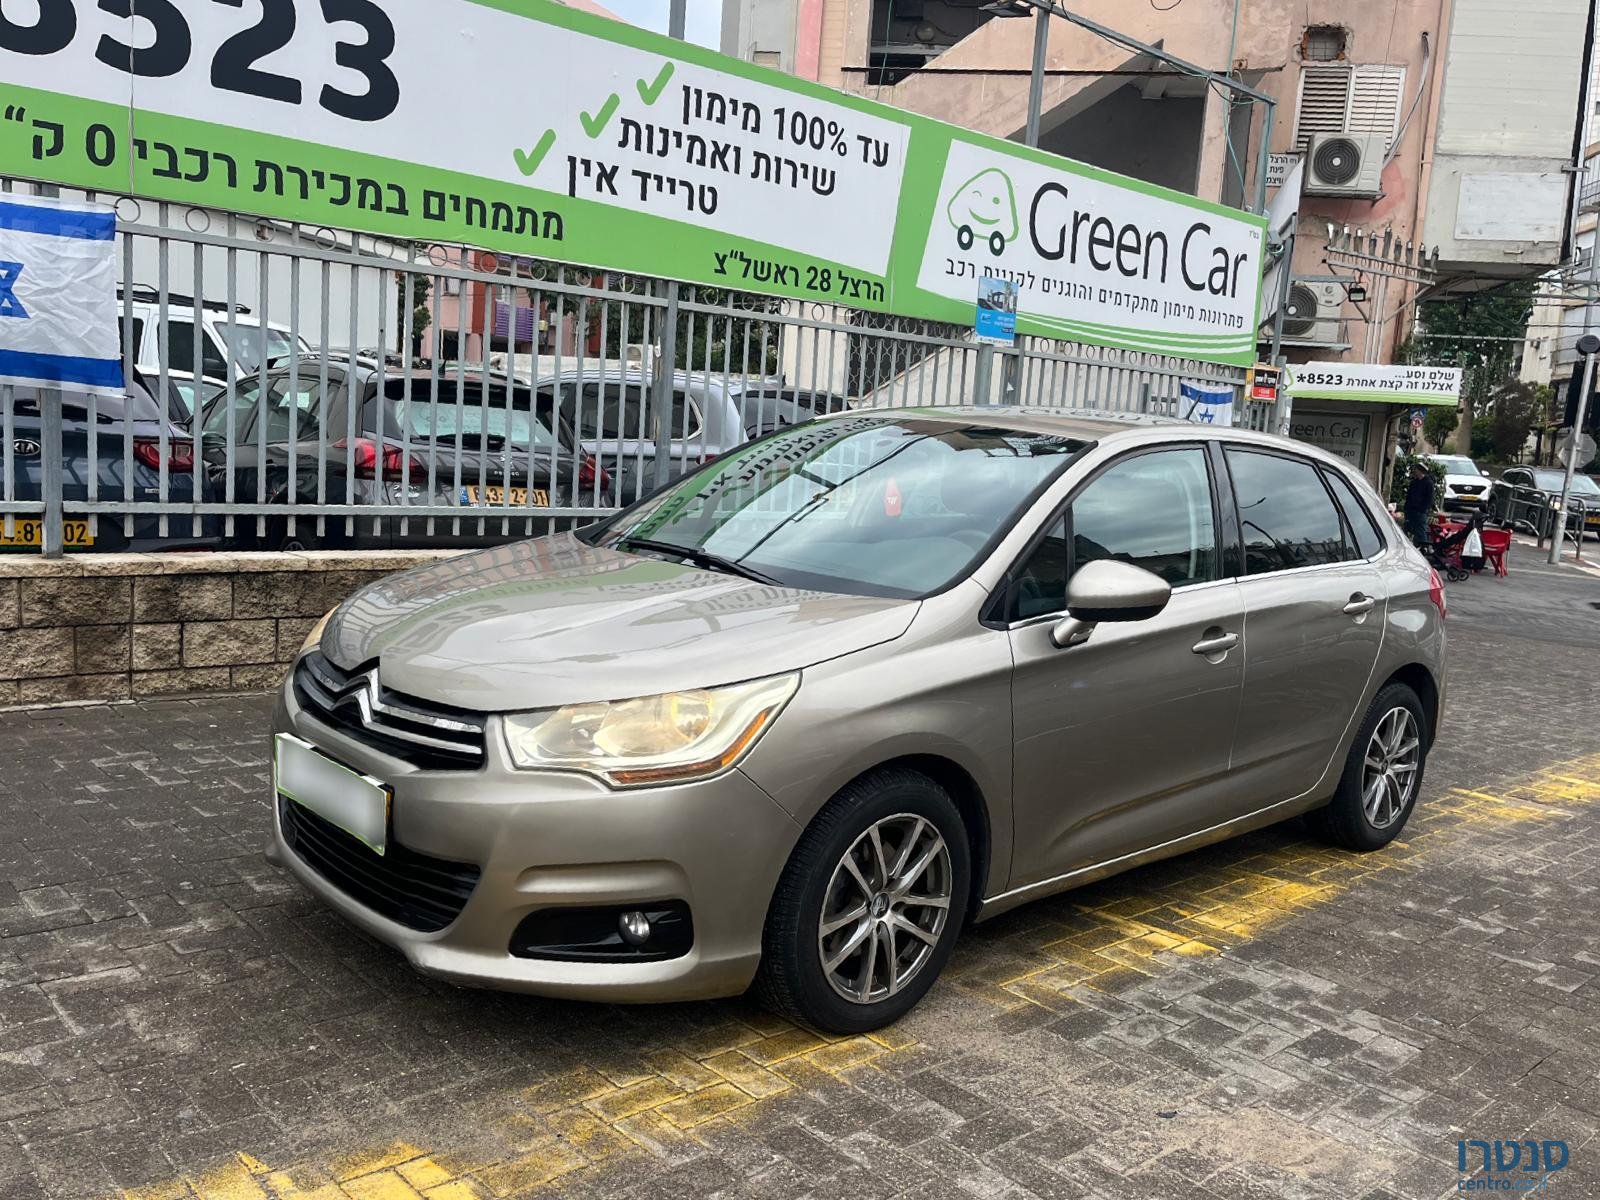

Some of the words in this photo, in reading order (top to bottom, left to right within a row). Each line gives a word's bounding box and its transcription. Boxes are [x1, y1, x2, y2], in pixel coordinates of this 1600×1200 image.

[682, 85, 761, 134] מימון
[86, 124, 116, 168] 0
[774, 108, 847, 157] 100%
[618, 118, 742, 175] ואמינות
[856, 135, 889, 168] עד
[1270, 154, 1288, 164] הרצל
[133, 138, 238, 189] רכבי
[750, 151, 836, 196] שירות
[1269, 165, 1285, 174] פינת
[253, 160, 410, 217] במכירת
[567, 156, 620, 199] אין
[632, 170, 718, 215] טרייד
[422, 190, 564, 242] מתמחים
[1029, 182, 1168, 284] Green
[1180, 222, 1248, 299] Car
[806, 266, 832, 293] 28
[946, 258, 975, 279] רכב
[837, 270, 885, 302] הרצל
[1042, 277, 1092, 301] והוגנים
[1098, 288, 1158, 313] מתקדמים
[1163, 301, 1195, 319] מימון
[1199, 308, 1244, 329] פתרונות
[1346, 378, 1377, 389] אחרת
[1379, 380, 1403, 391] קצת
[1405, 381, 1419, 390] זה
[1421, 380, 1454, 392] אצלנו
[1429, 370, 1455, 381] שלם
[1290, 423, 1325, 437] reen
[1329, 422, 1359, 438] Car
